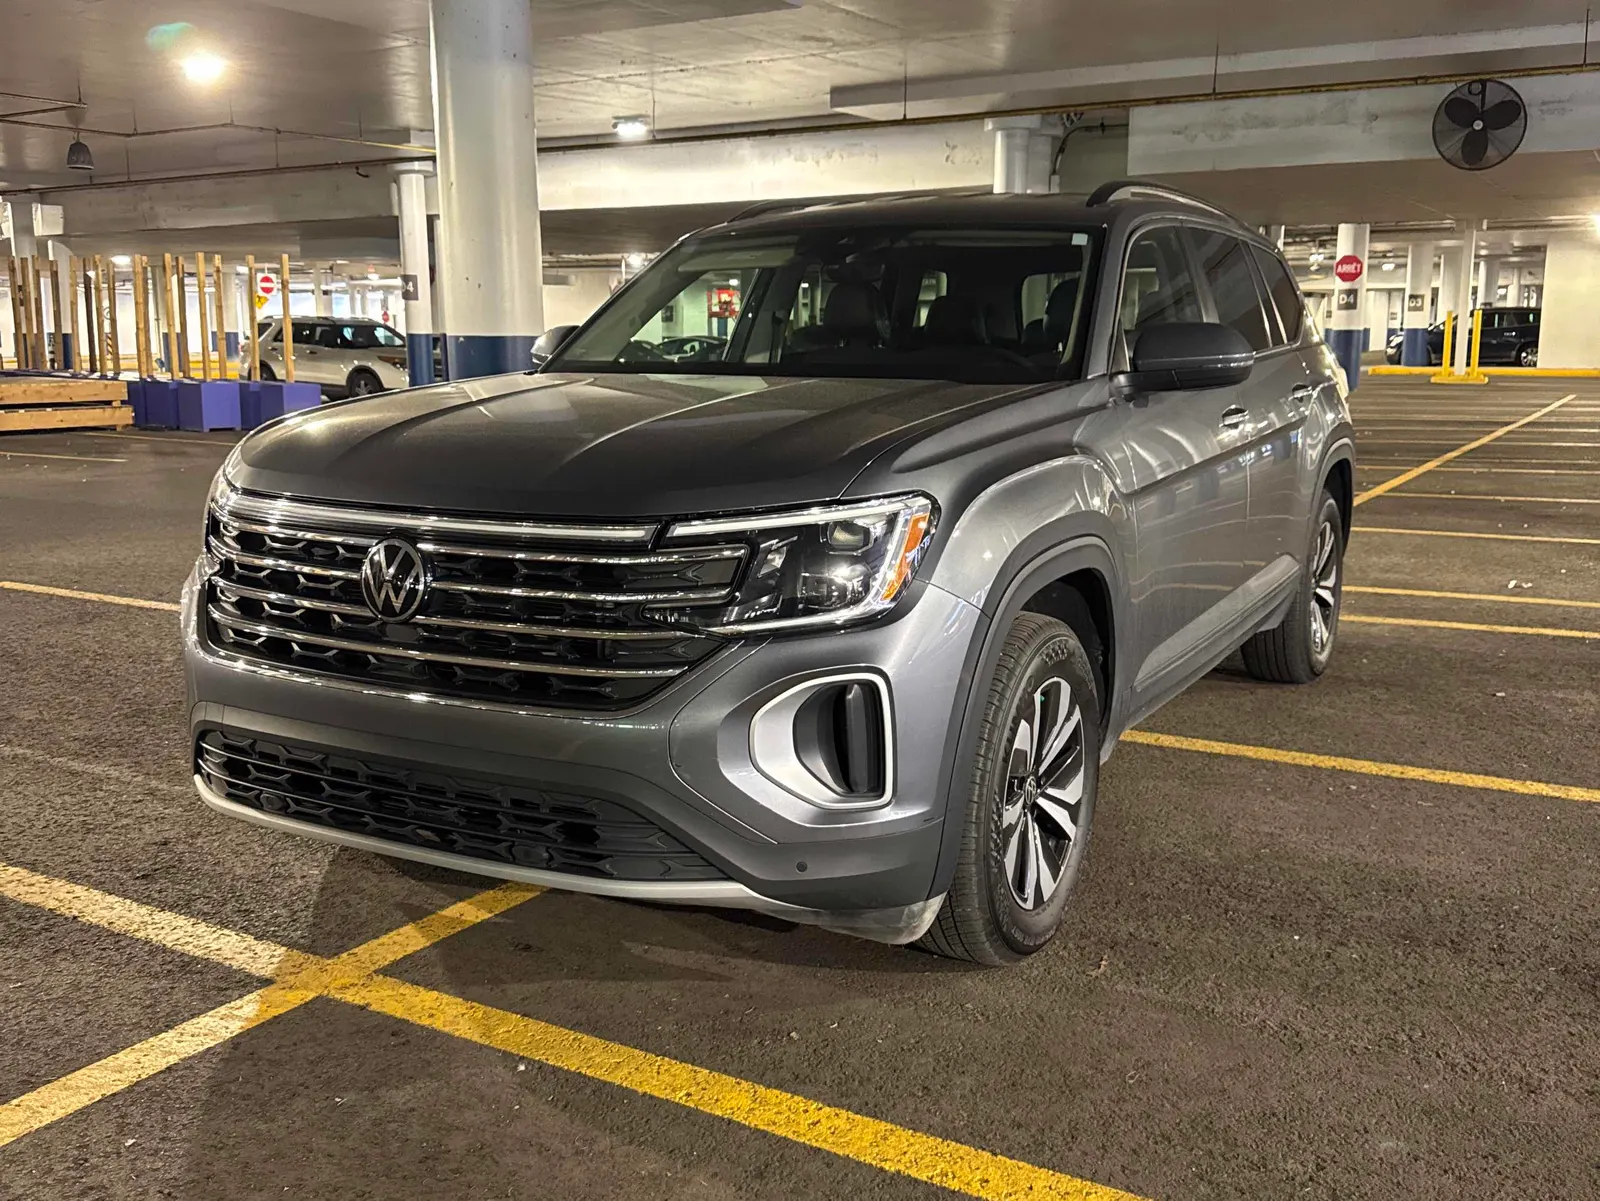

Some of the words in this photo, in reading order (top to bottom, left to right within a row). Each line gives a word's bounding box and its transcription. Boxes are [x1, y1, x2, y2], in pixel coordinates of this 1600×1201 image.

[1339, 294, 1354, 304] D4
[1409, 298, 1422, 307] D3
[363, 539, 424, 623] VW
